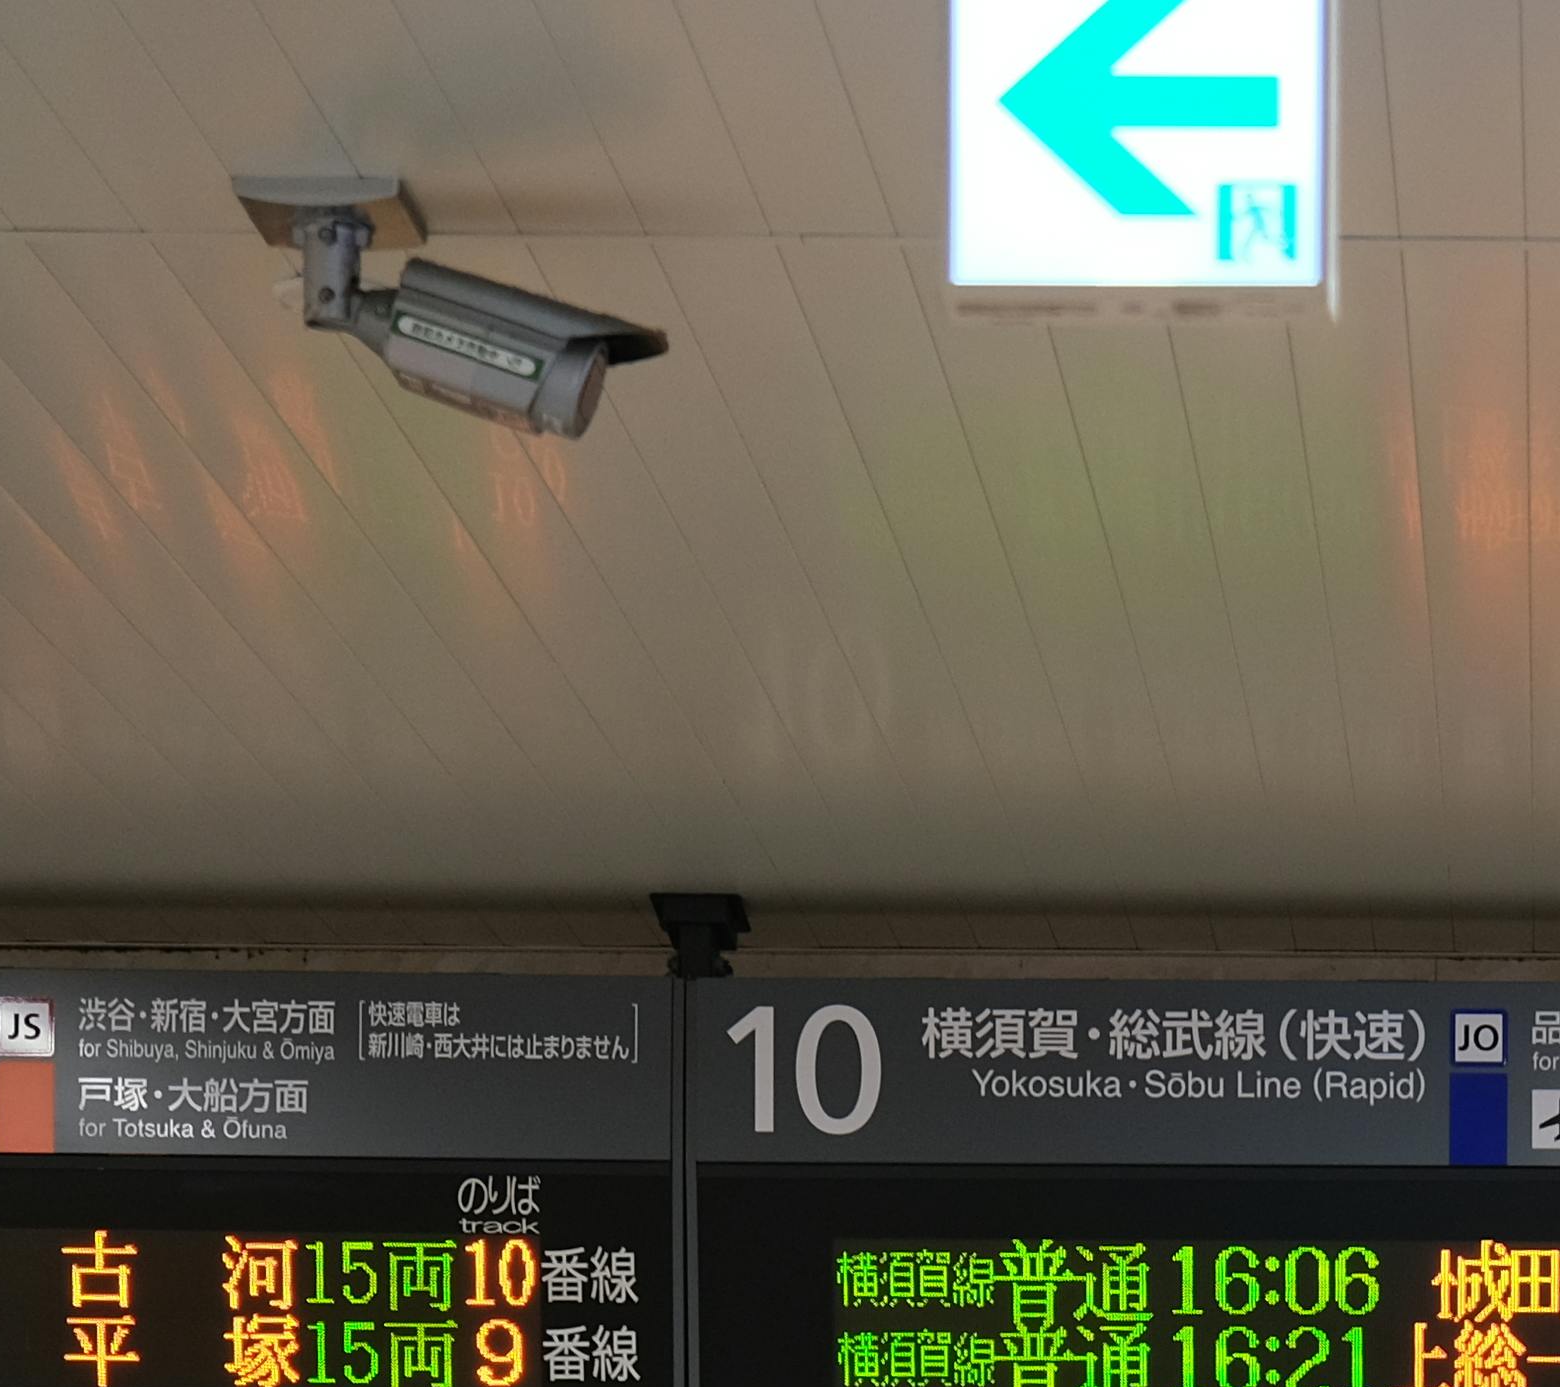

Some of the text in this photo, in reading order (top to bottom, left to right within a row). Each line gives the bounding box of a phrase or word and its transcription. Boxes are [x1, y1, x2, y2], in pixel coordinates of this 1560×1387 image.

[7, 1012, 42, 1042] JS
[78, 997, 337, 1037] 渋谷・新宿・大宮方面
[368, 1001, 460, 1028] 快速電車は
[78, 1037, 336, 1064] for Shibuya, Shinjuku & Ōmiya
[368, 1032, 630, 1061] 新川崎・西大井には止まりません
[1459, 1025, 1500, 1053] JO
[726, 1004, 882, 1135] 10
[1532, 1051, 1557, 1073] for
[77, 1077, 309, 1115] 戸塚・大船方面
[1238, 1071, 1300, 1099] Line
[1312, 1069, 1426, 1104] (Rapid)
[78, 1116, 288, 1141] for Totsuka & Ōfuna
[457, 1174, 540, 1217] のりば
[460, 1218, 539, 1235] track
[465, 1238, 536, 1307] 10
[541, 1246, 639, 1304] 番線
[836, 1250, 995, 1308] 横須賀線
[992, 1239, 1154, 1325] 普通
[1171, 1245, 1380, 1316] 16:06
[476, 1318, 525, 1387] 9
[543, 1325, 642, 1384] 番線
